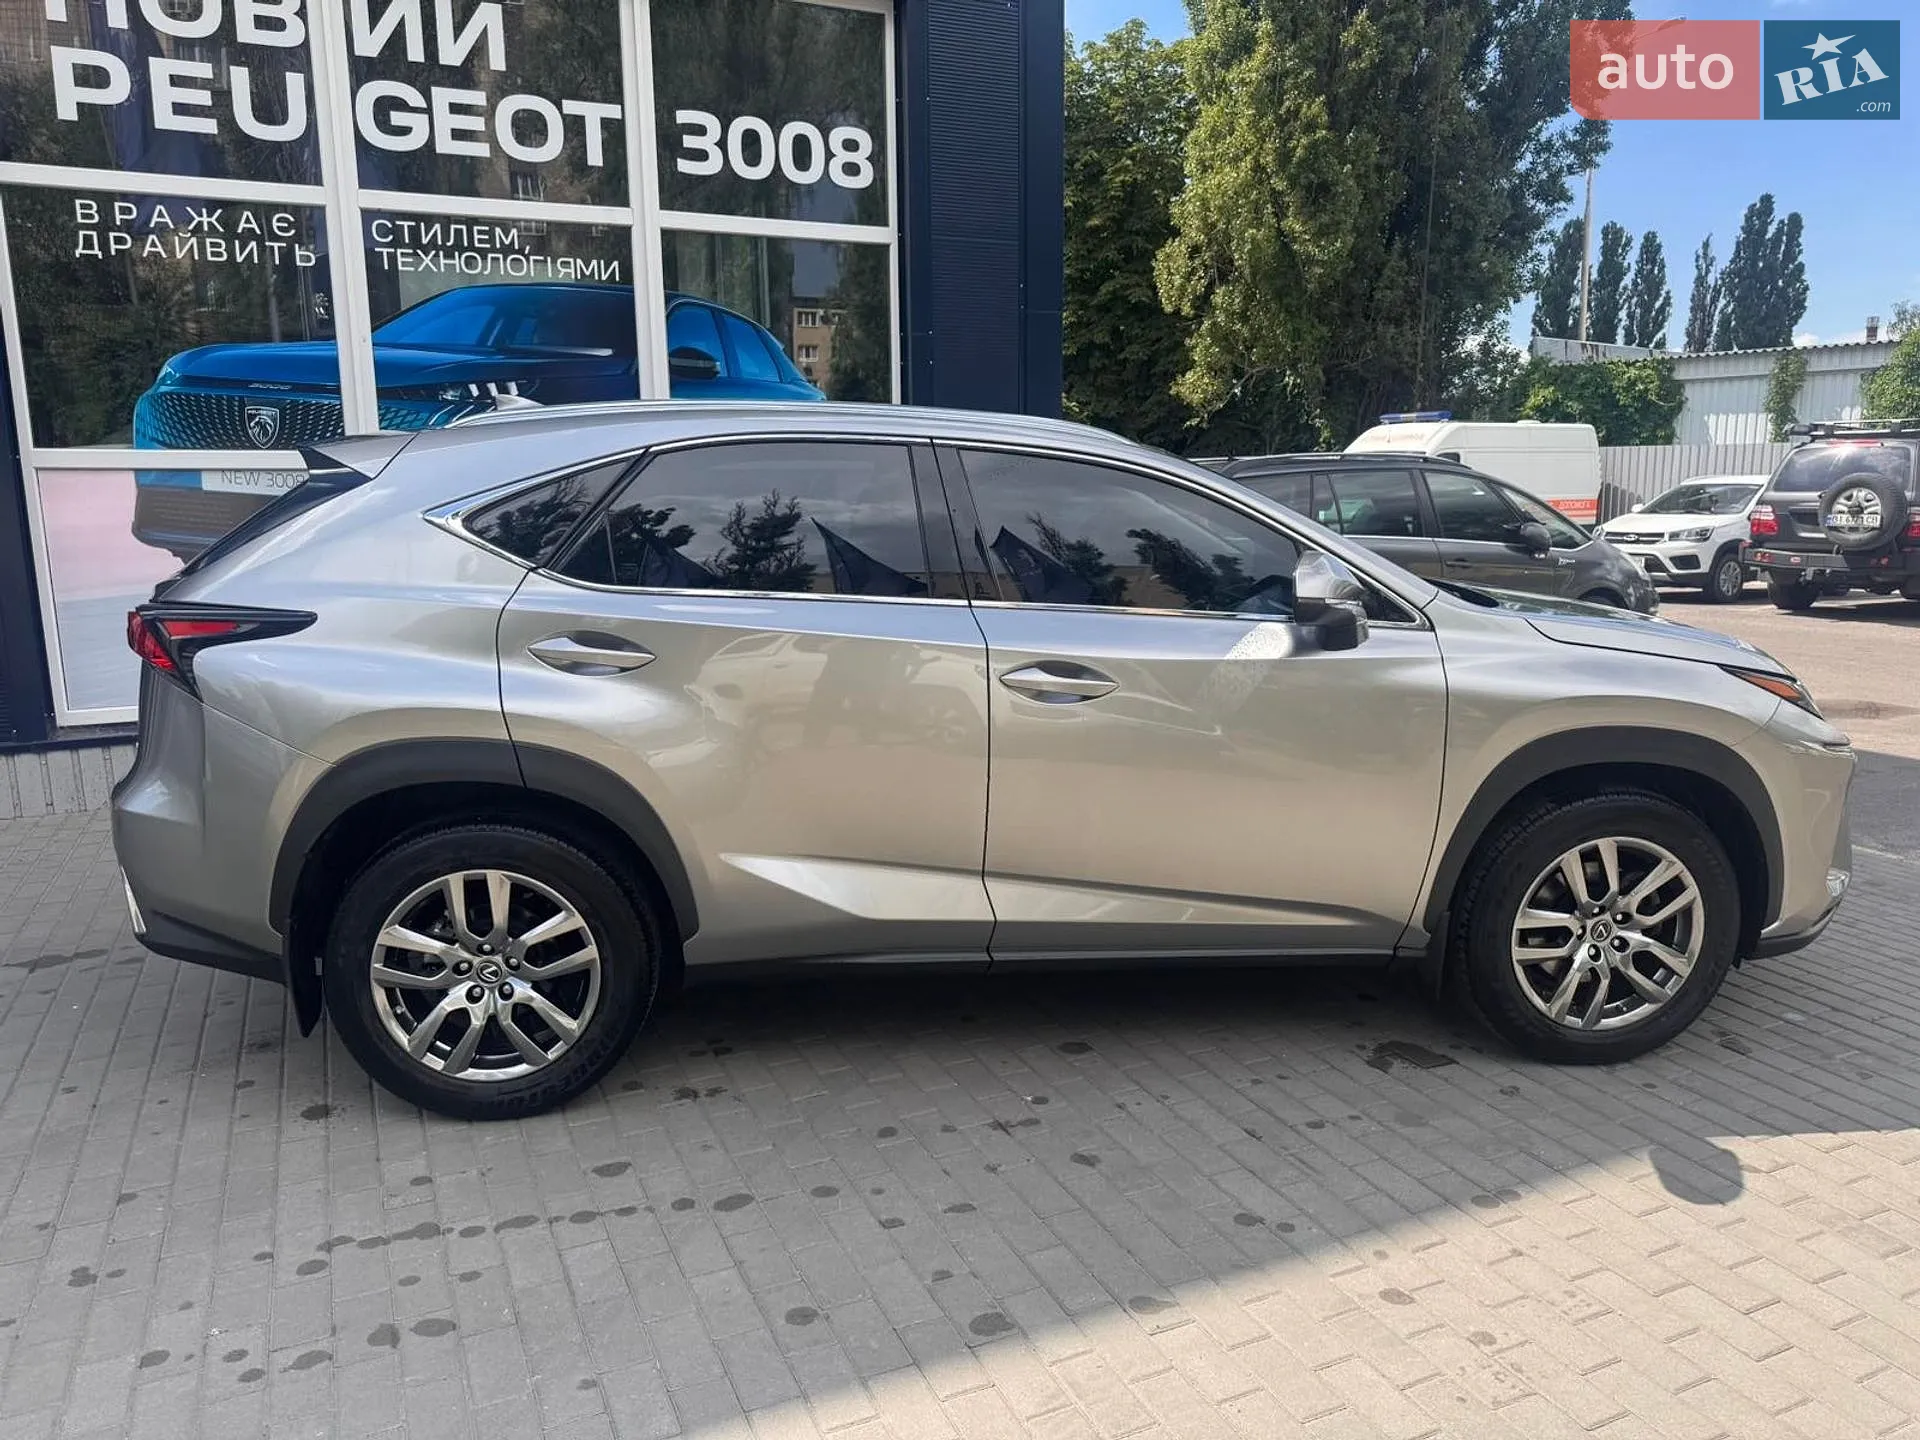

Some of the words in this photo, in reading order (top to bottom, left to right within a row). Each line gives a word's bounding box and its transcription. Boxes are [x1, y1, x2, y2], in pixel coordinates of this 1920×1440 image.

[50, 45, 623, 167] PEUGEOT
[675, 109, 874, 190] 3008
[74, 198, 297, 238] ВРАЖАЄ
[371, 218, 531, 255] СТИЛЕМ,
[74, 230, 317, 268] ДРАЙВИТЬ
[374, 246, 620, 283] ТЕХНОЛОГІЯМИ
[221, 470, 260, 486] NEW
